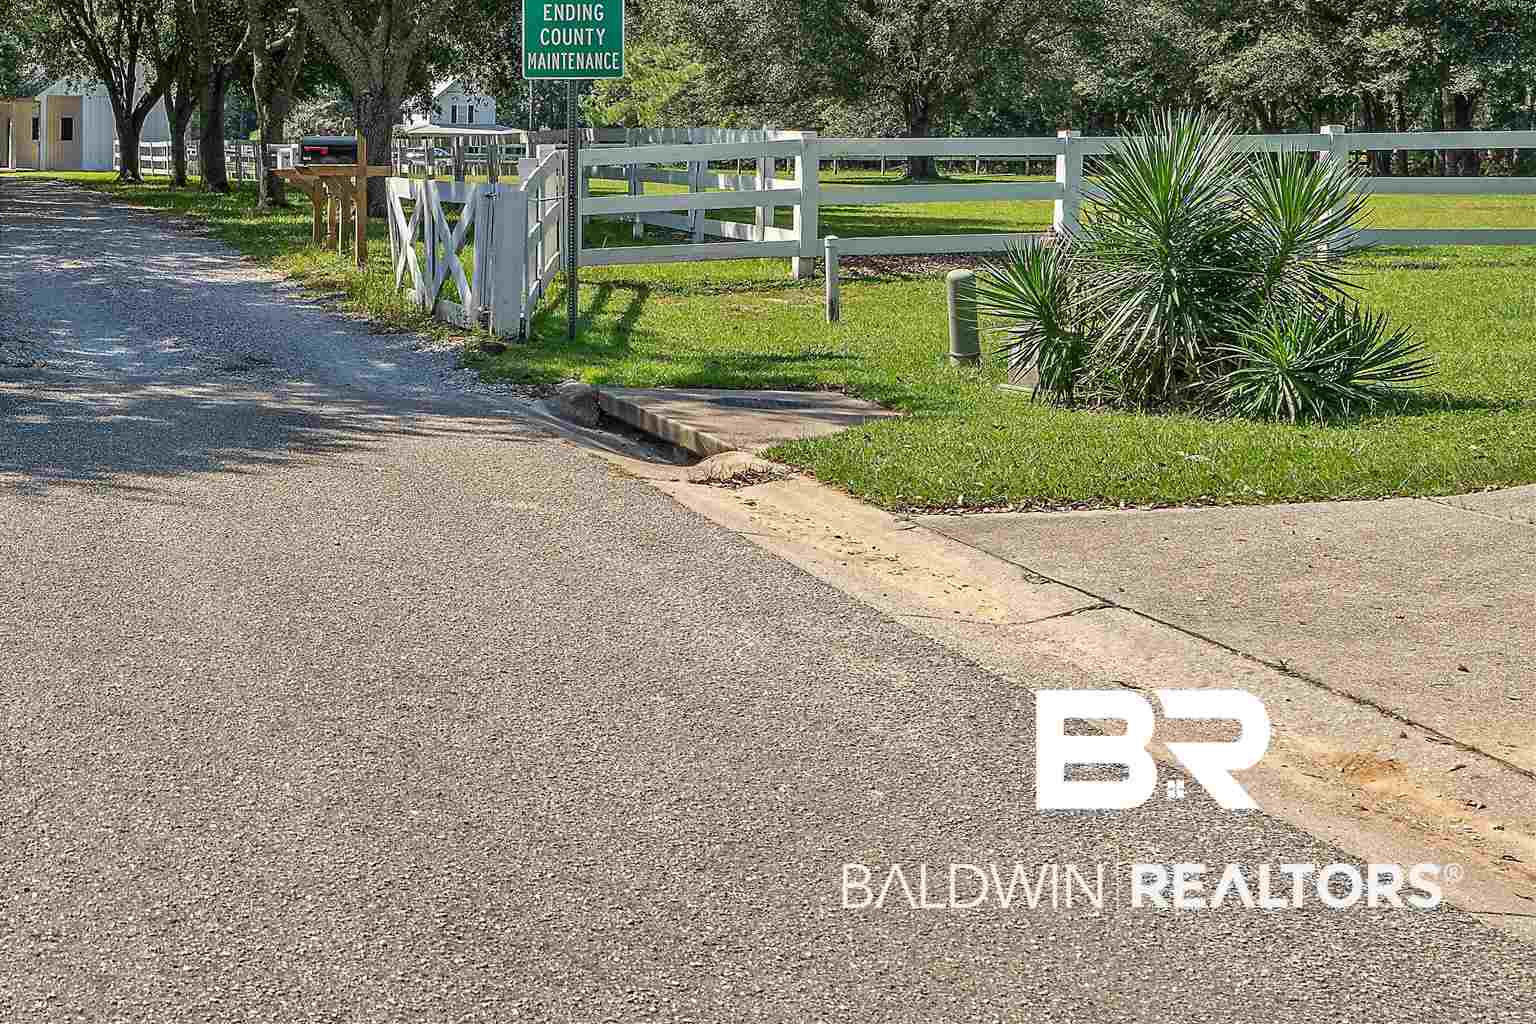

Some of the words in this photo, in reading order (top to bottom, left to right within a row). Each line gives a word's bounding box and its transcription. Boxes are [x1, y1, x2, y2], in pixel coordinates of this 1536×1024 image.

[543, 3, 604, 22] ENDING
[540, 27, 606, 46] COUNTY
[527, 52, 620, 70] MAINTENANCE
